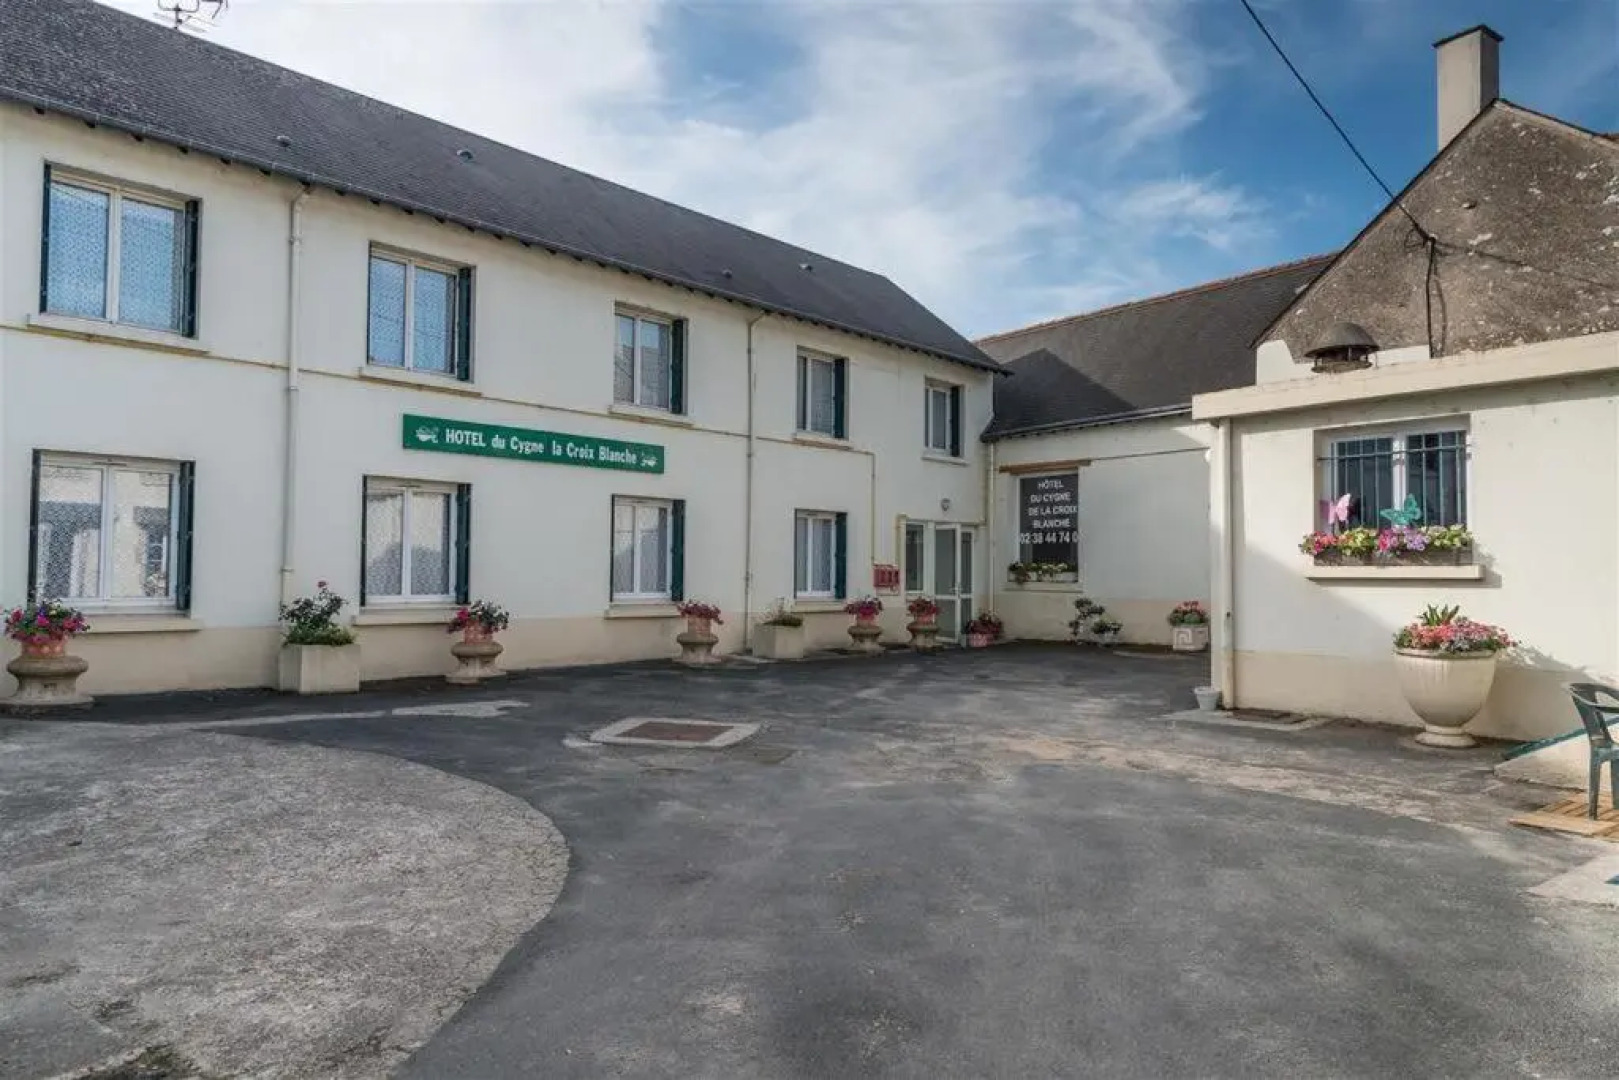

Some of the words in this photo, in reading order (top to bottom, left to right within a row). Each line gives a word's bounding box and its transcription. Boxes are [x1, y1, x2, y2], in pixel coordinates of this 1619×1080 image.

[445, 428, 486, 447] HOTEL
[491, 435, 506, 449] du
[510, 436, 545, 455] Cygne
[552, 441, 563, 456] la
[566, 443, 595, 460] Croix
[599, 446, 637, 464] Blanche
